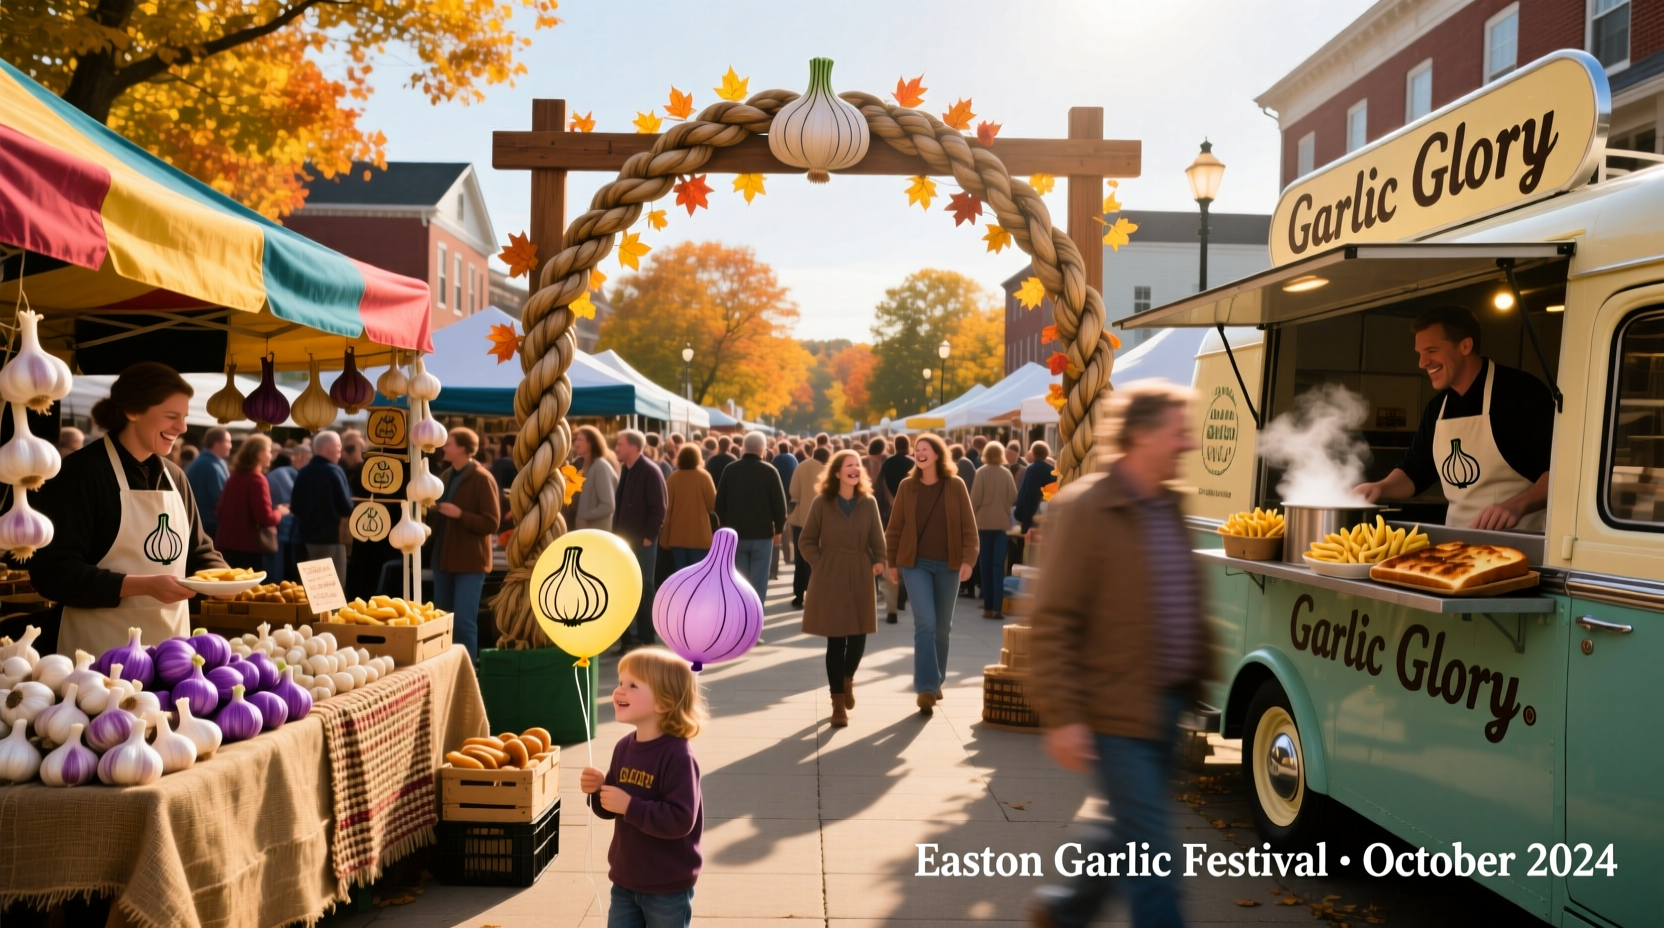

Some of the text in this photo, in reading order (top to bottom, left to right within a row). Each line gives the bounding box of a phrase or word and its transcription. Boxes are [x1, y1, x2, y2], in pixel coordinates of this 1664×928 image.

[1288, 110, 1559, 255] Garlic Glory
[1290, 593, 1386, 677] Garlic
